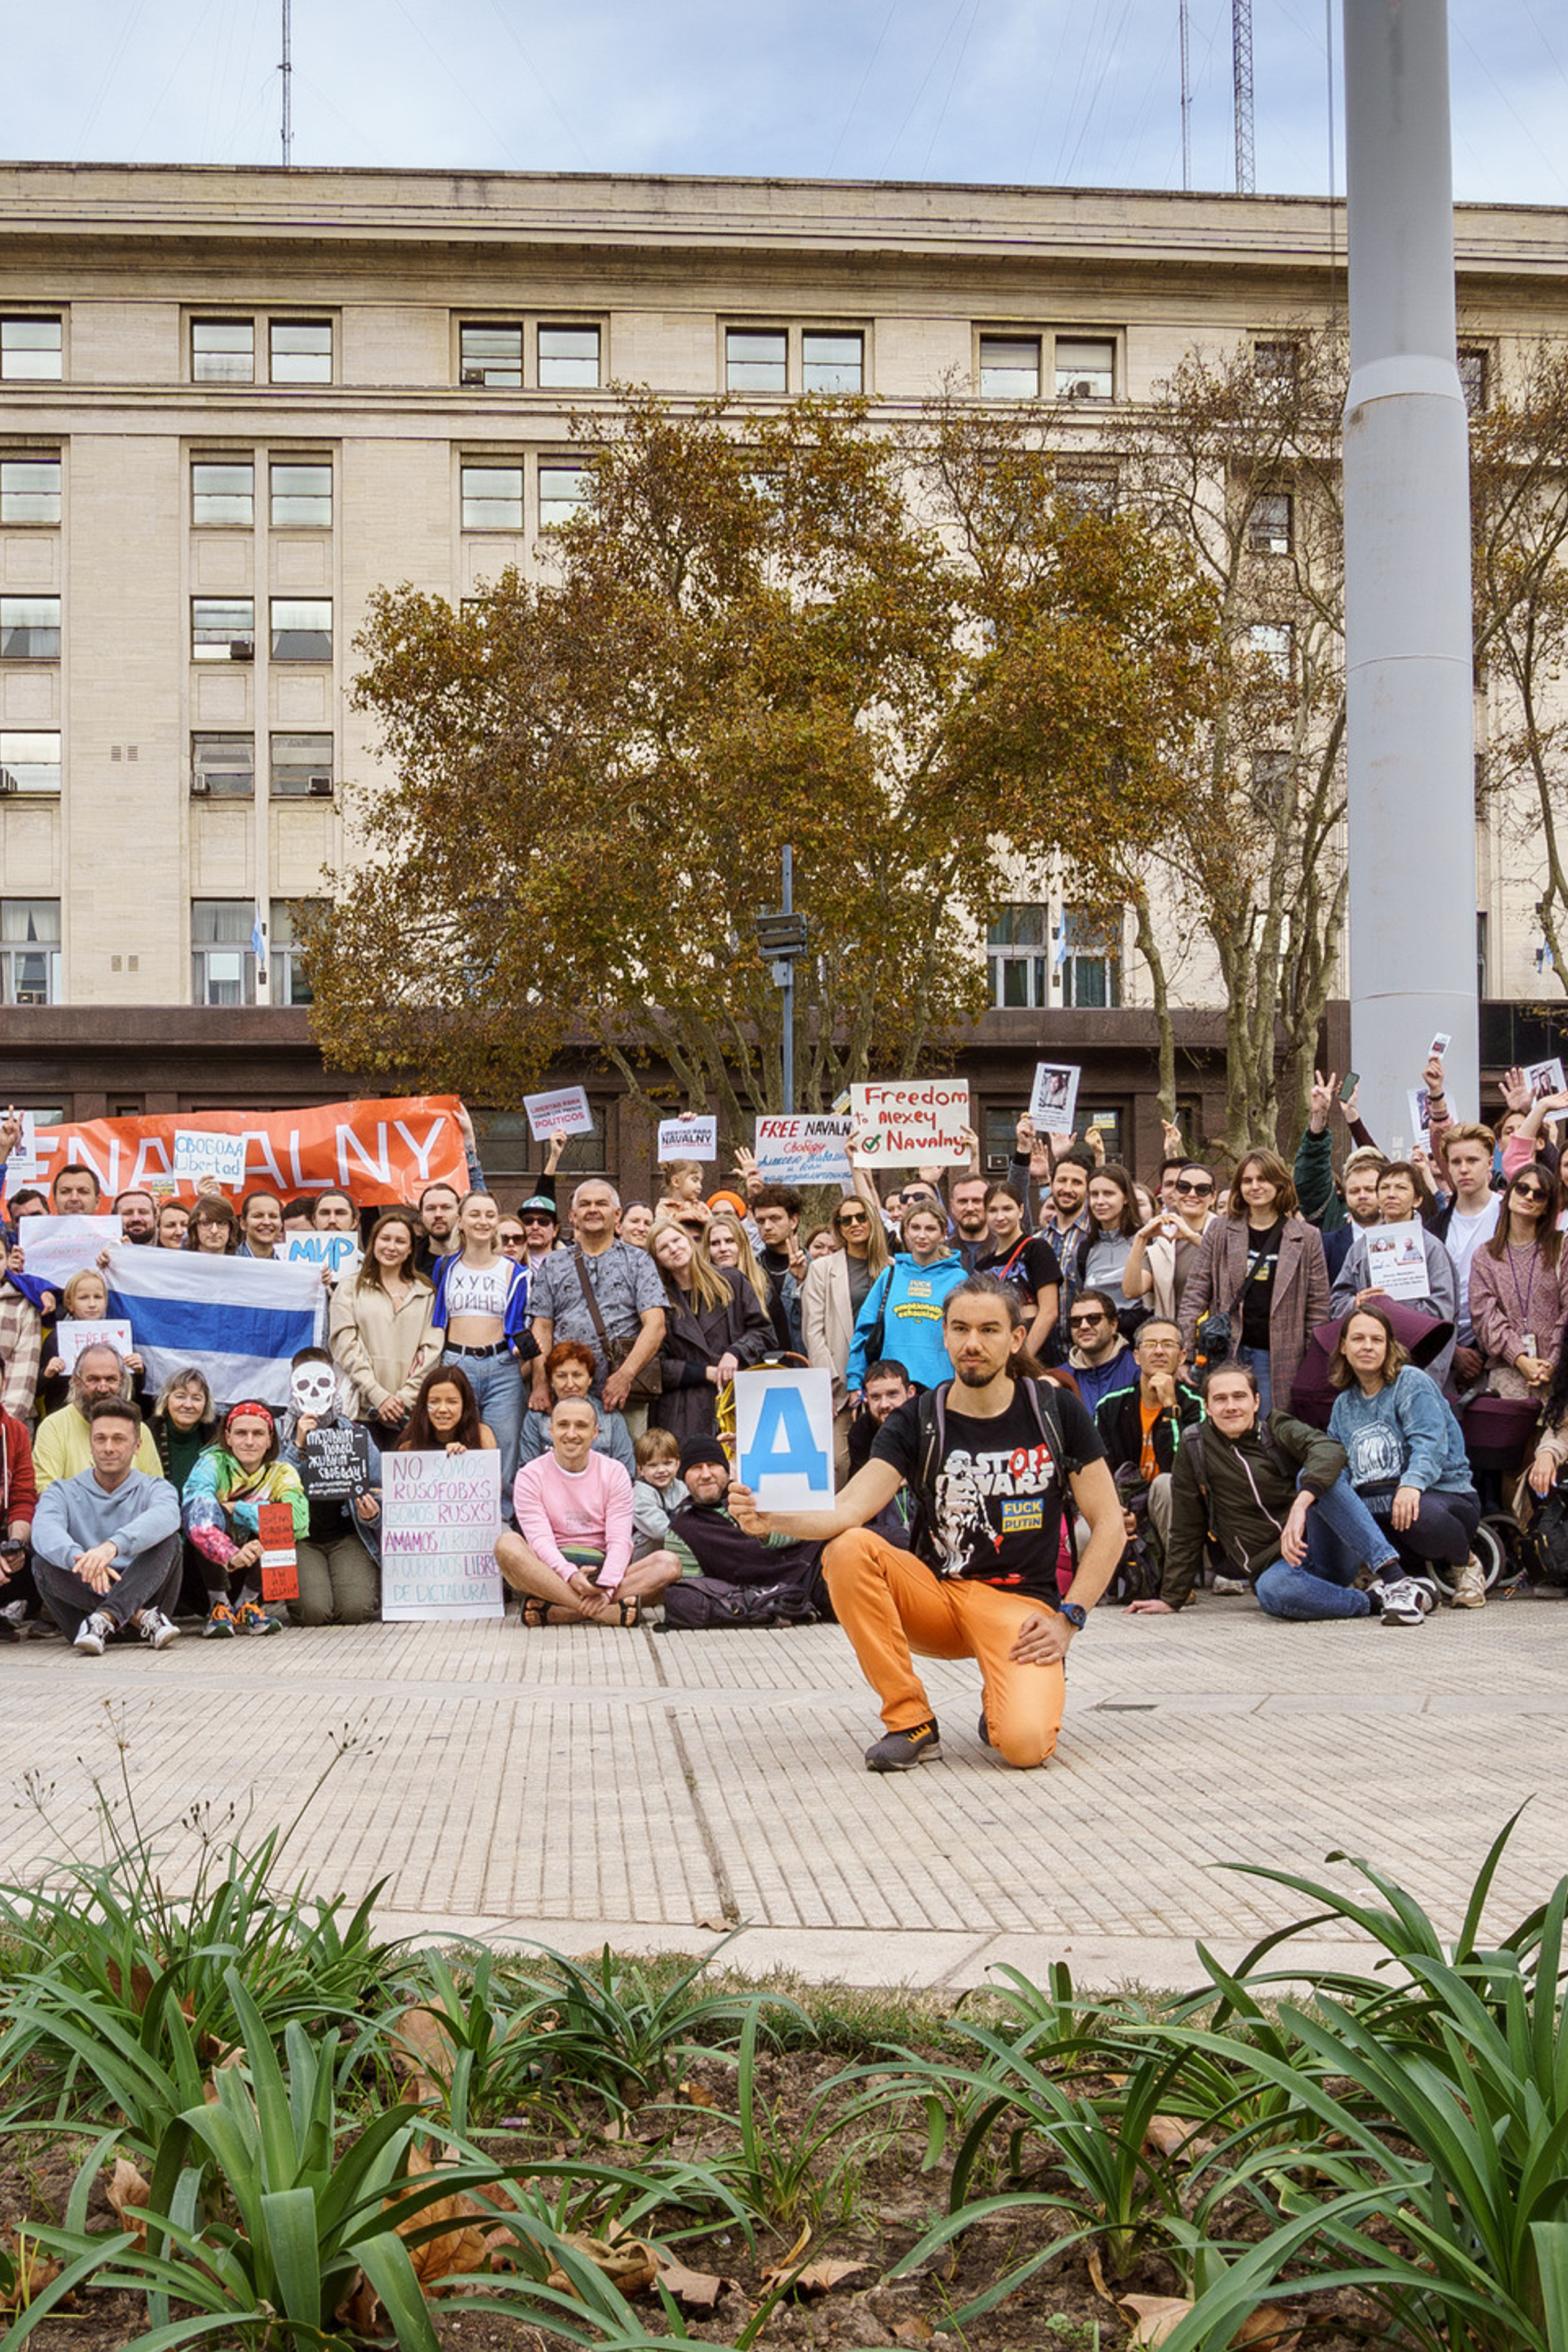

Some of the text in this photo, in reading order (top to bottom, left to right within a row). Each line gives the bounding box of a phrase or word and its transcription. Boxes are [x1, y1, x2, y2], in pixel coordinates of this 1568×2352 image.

[865, 1085, 968, 1106] Freedom
[759, 1120, 853, 1139] FREE NAVALN
[878, 1110, 936, 1130] Alexey
[175, 1136, 243, 1156] СВОБОДА
[662, 1134, 711, 1144] NAVALNY
[886, 1129, 967, 1156] Navalny
[289, 1237, 354, 1272] МИР
[75, 1332, 111, 1350] FREE
[393, 1456, 485, 1481] NO SOMOS
[389, 1502, 492, 1524] SOMOS RUSXS
[1003, 1501, 1041, 1515] FUCK
[1005, 1518, 1041, 1530] PUTIN
[385, 1530, 438, 1552] AMAMOS
[393, 1584, 411, 1602] DE
